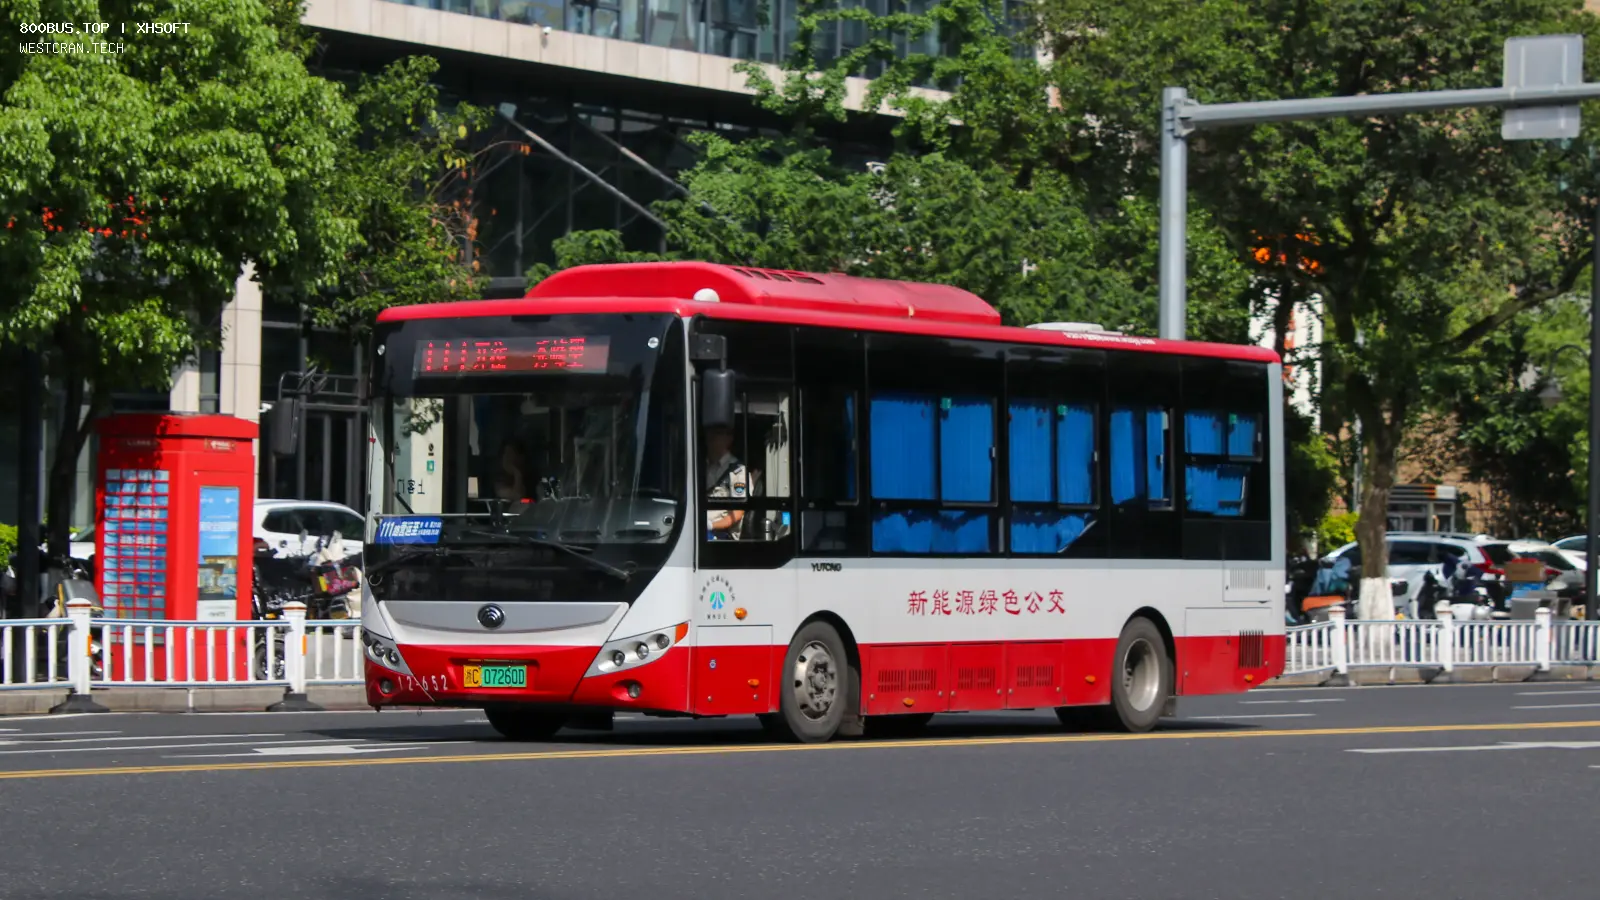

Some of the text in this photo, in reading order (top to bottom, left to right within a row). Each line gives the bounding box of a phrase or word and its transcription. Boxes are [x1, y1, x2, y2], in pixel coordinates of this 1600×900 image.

[811, 562, 842, 572] YUTONG
[907, 588, 1066, 616] 新能源绿色公交
